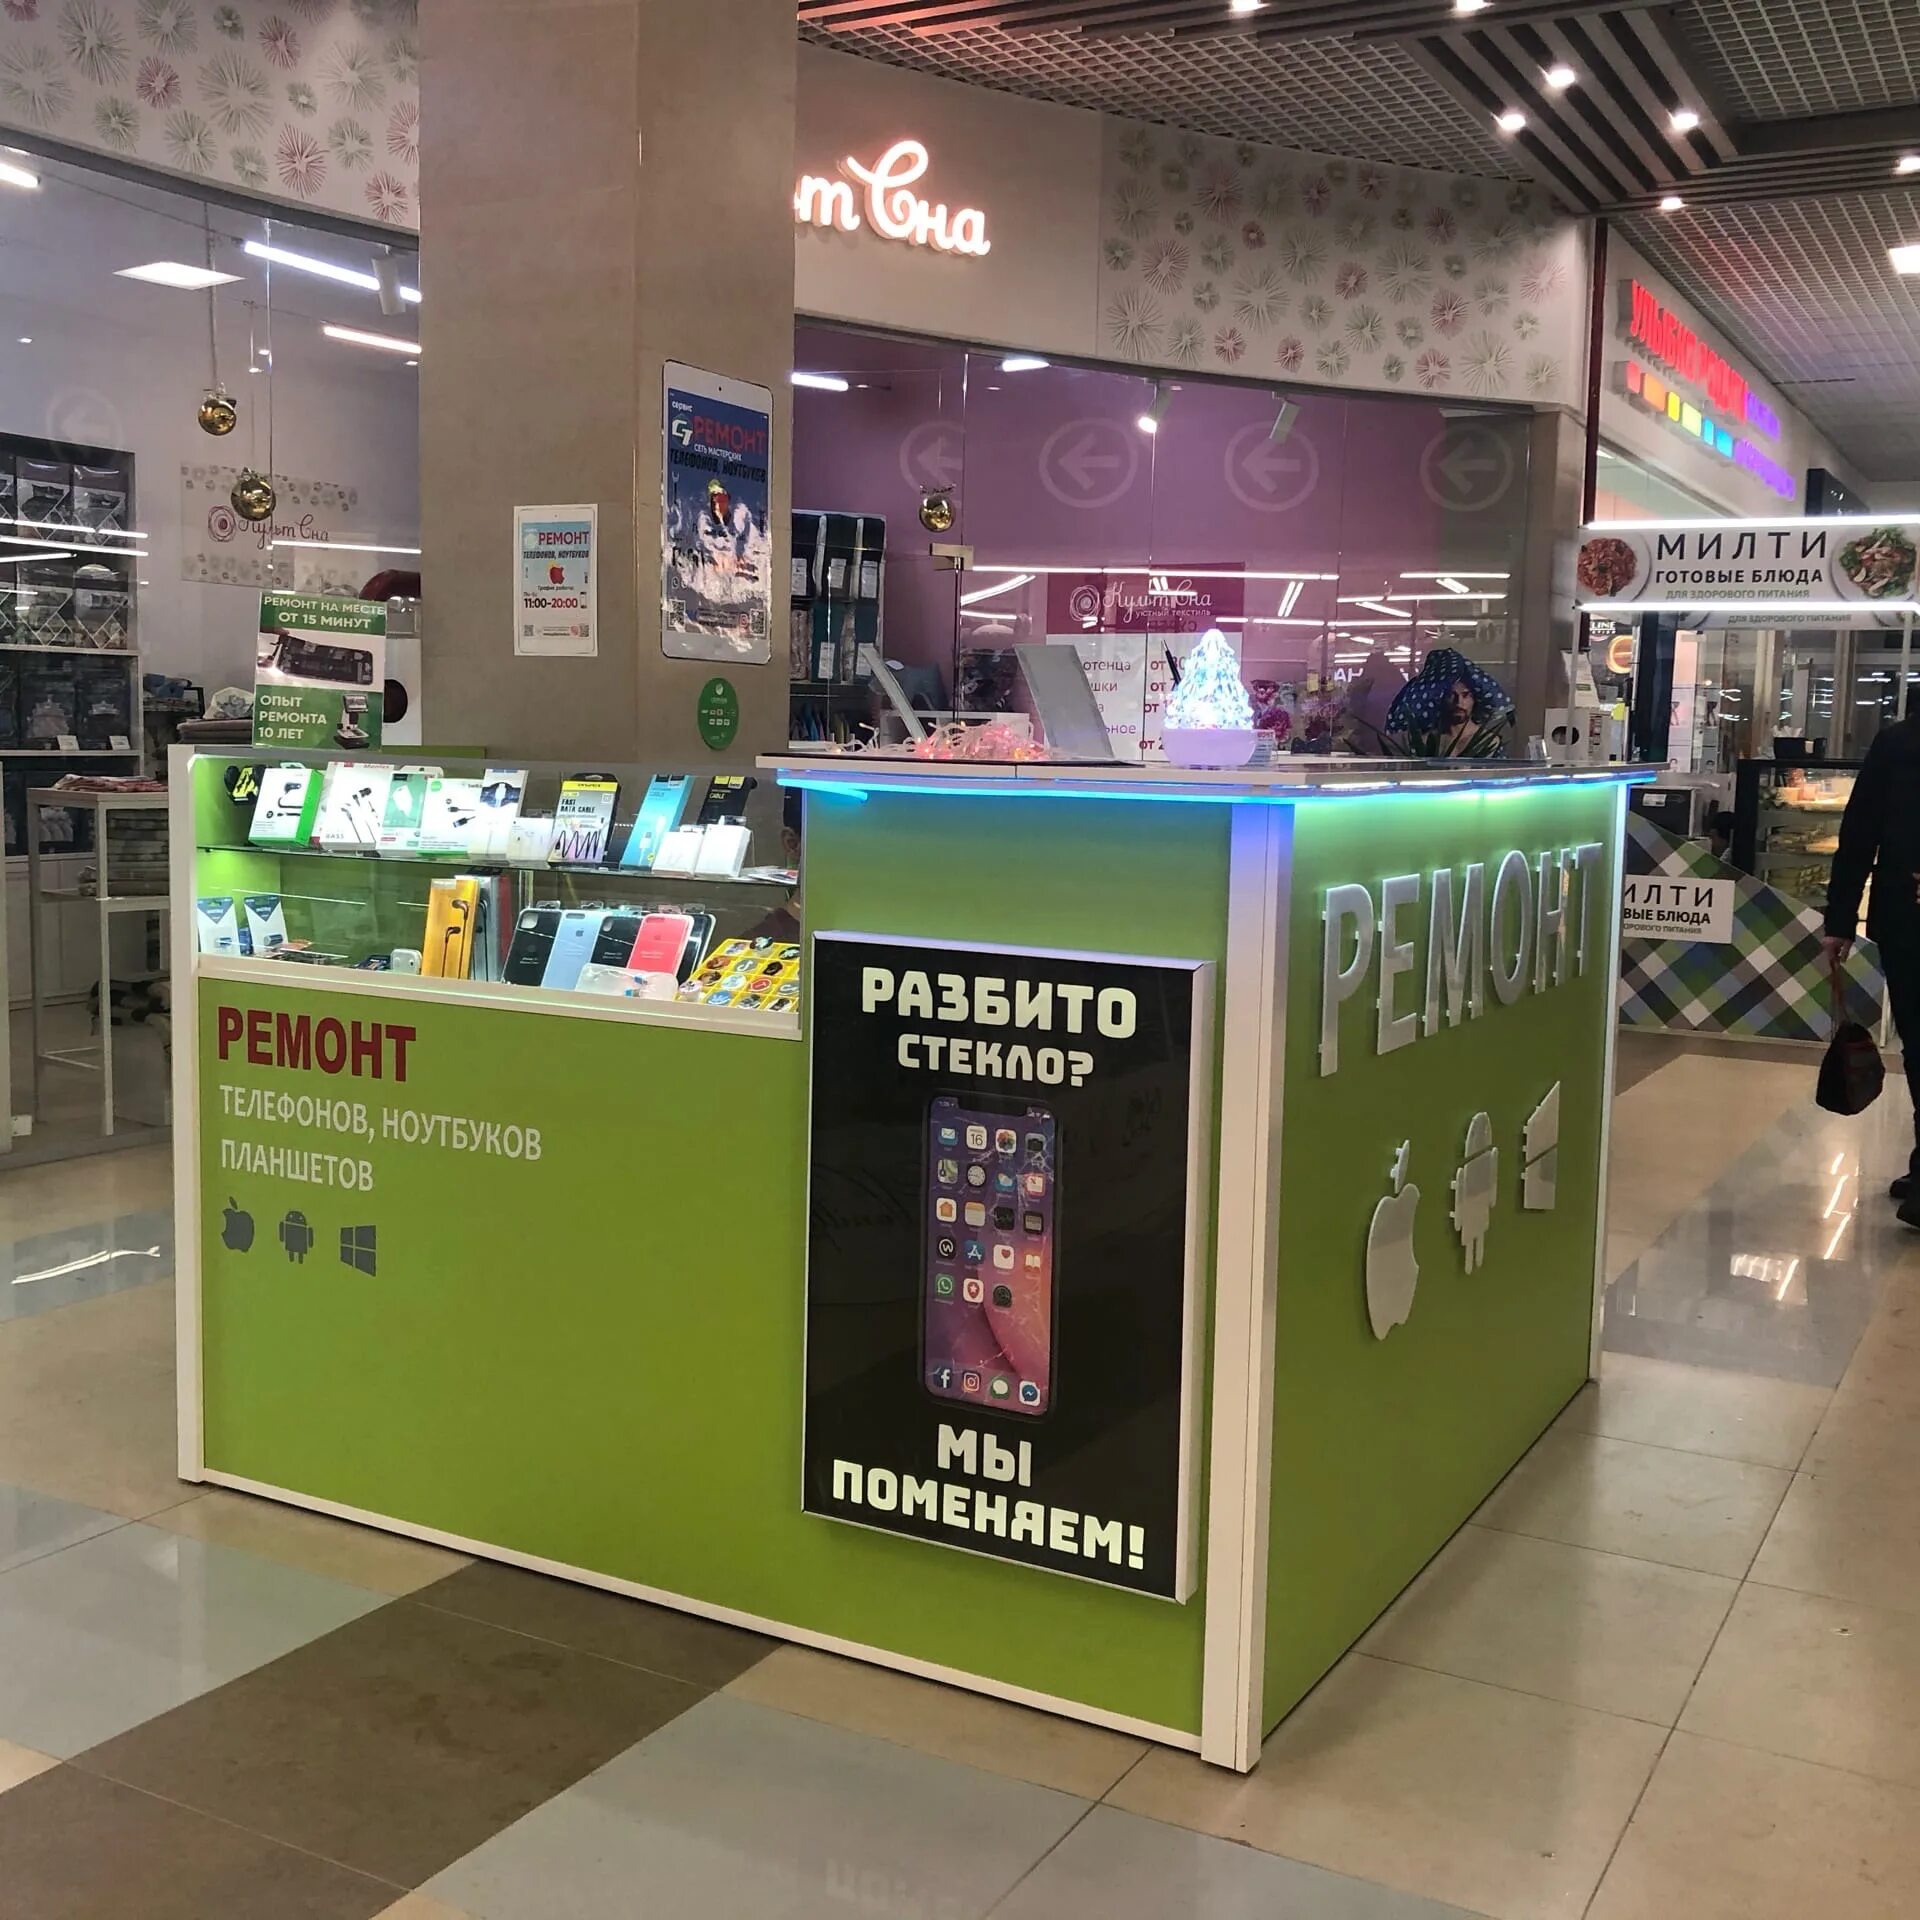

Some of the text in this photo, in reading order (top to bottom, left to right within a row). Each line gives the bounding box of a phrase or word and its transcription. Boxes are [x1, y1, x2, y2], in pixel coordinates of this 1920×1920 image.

[693, 415, 766, 455] РЕМОНТ
[538, 531, 590, 545] РЕМОНТ
[1657, 531, 1827, 560] МИЛТИ
[1656, 569, 1823, 585] ГОТОВЫЕ БЛЮДА
[1666, 588, 1810, 599] ДЛЯ ЗДОРОВОГО ПИТАНИЯ
[264, 597, 386, 615] РЕМОНТ НА МЕСТЕ
[524, 598, 578, 609] 11:00-20:00
[278, 612, 372, 629] ОТ 15 МИНУТ
[1135, 609, 1212, 618] уютный текстиль
[1728, 614, 1852, 624] ДЛЯ ЗДОРОВОГО ПИТАНИЯ
[1150, 660, 1166, 670] от
[1150, 682, 1166, 692] от
[260, 695, 303, 707] ОПЫТ
[1144, 703, 1159, 713] от
[259, 711, 327, 724] РЕМОНТА
[258, 727, 304, 739] 10 ЛЕТ
[1139, 740, 1155, 750] от
[1656, 900, 1711, 926] БЛЮДА
[1663, 925, 1702, 935] ПИТАНИЯ
[1319, 842, 1603, 1078] РЕМОНТ
[861, 966, 1137, 1039] РАЗБИТО
[218, 1005, 417, 1083] РЕМОНТ
[898, 1034, 1094, 1087] СТЕКЛО?
[219, 1084, 542, 1161] ТЕЛЕФОНОВ, НОУТБУКОВ
[970, 1133, 984, 1146] 16
[221, 1138, 373, 1192] ПЛАНШЕТОВ
[937, 1423, 1032, 1487] МЫ
[832, 1458, 1145, 1570] ПОМЕНЯЕМ!
